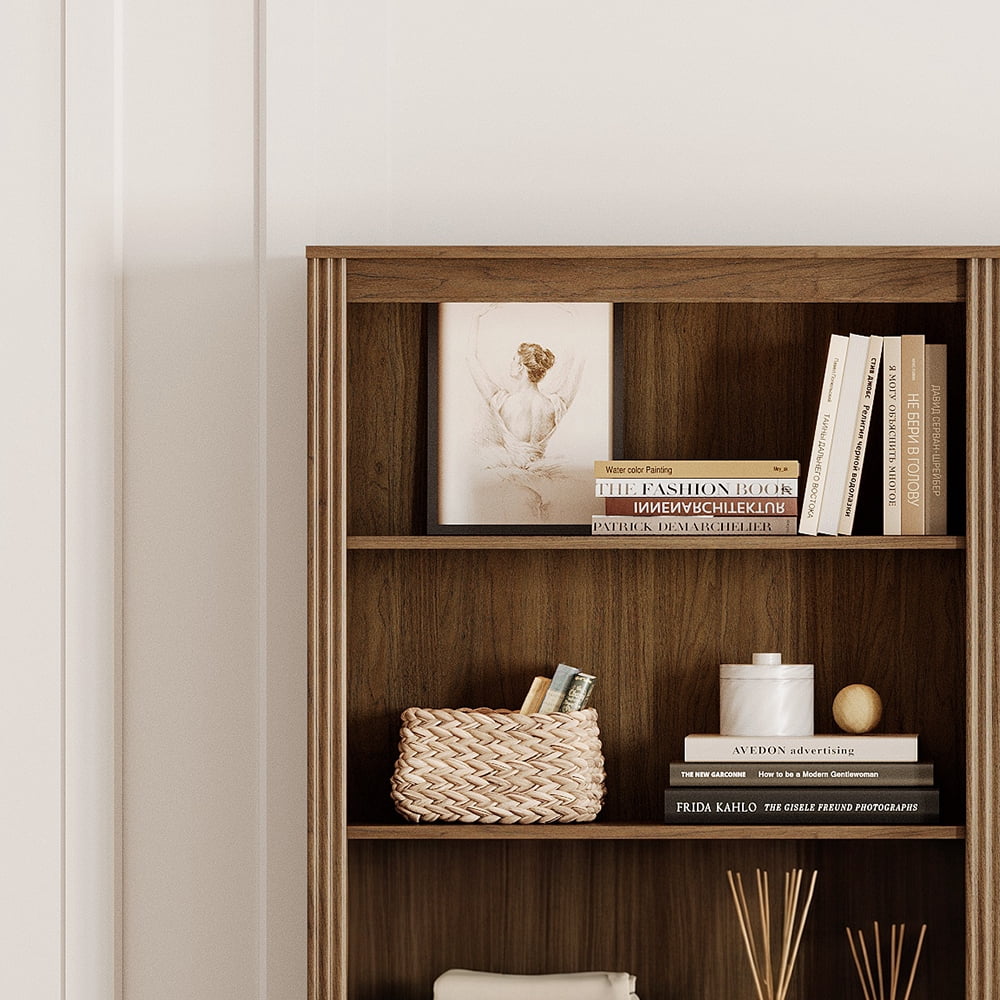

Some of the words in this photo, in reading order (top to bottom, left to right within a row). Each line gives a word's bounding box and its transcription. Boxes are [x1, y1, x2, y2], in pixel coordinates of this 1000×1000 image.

[888, 374, 896, 401] МОГУ
[907, 393, 920, 409] НЕ
[930, 384, 941, 414] ДАВИД
[857, 404, 870, 439] Религия
[888, 404, 896, 463] ОБЪЯСНИТЬ
[907, 412, 920, 444] БЕРИ
[813, 440, 826, 481] ДАЛЬНЕГО
[907, 447, 920, 455] В
[932, 416, 942, 497] СЕРВАН-ШРЕЙБЕР
[605, 465, 626, 474] Water
[627, 465, 644, 474] color
[645, 465, 673, 476] Painting
[907, 458, 920, 507] ГОЛОВУ
[597, 483, 637, 496] THE
[642, 483, 729, 496] FASHION
[807, 482, 819, 519] ВОСТОКА
[844, 473, 858, 517] водолазки
[888, 466, 896, 507] МНОГОЕ
[593, 521, 653, 532] PATRICK
[658, 521, 773, 532] DEMARCHELIER
[732, 746, 786, 755] AVEDON
[790, 746, 855, 757] advertising
[676, 802, 712, 813] FRIDA
[716, 802, 757, 813] KAHLO
[764, 803, 782, 812] THE
[784, 803, 815, 812] GISELE
[818, 803, 853, 812] FREUND
[855, 803, 918, 812] PHOTOGRAPHS
